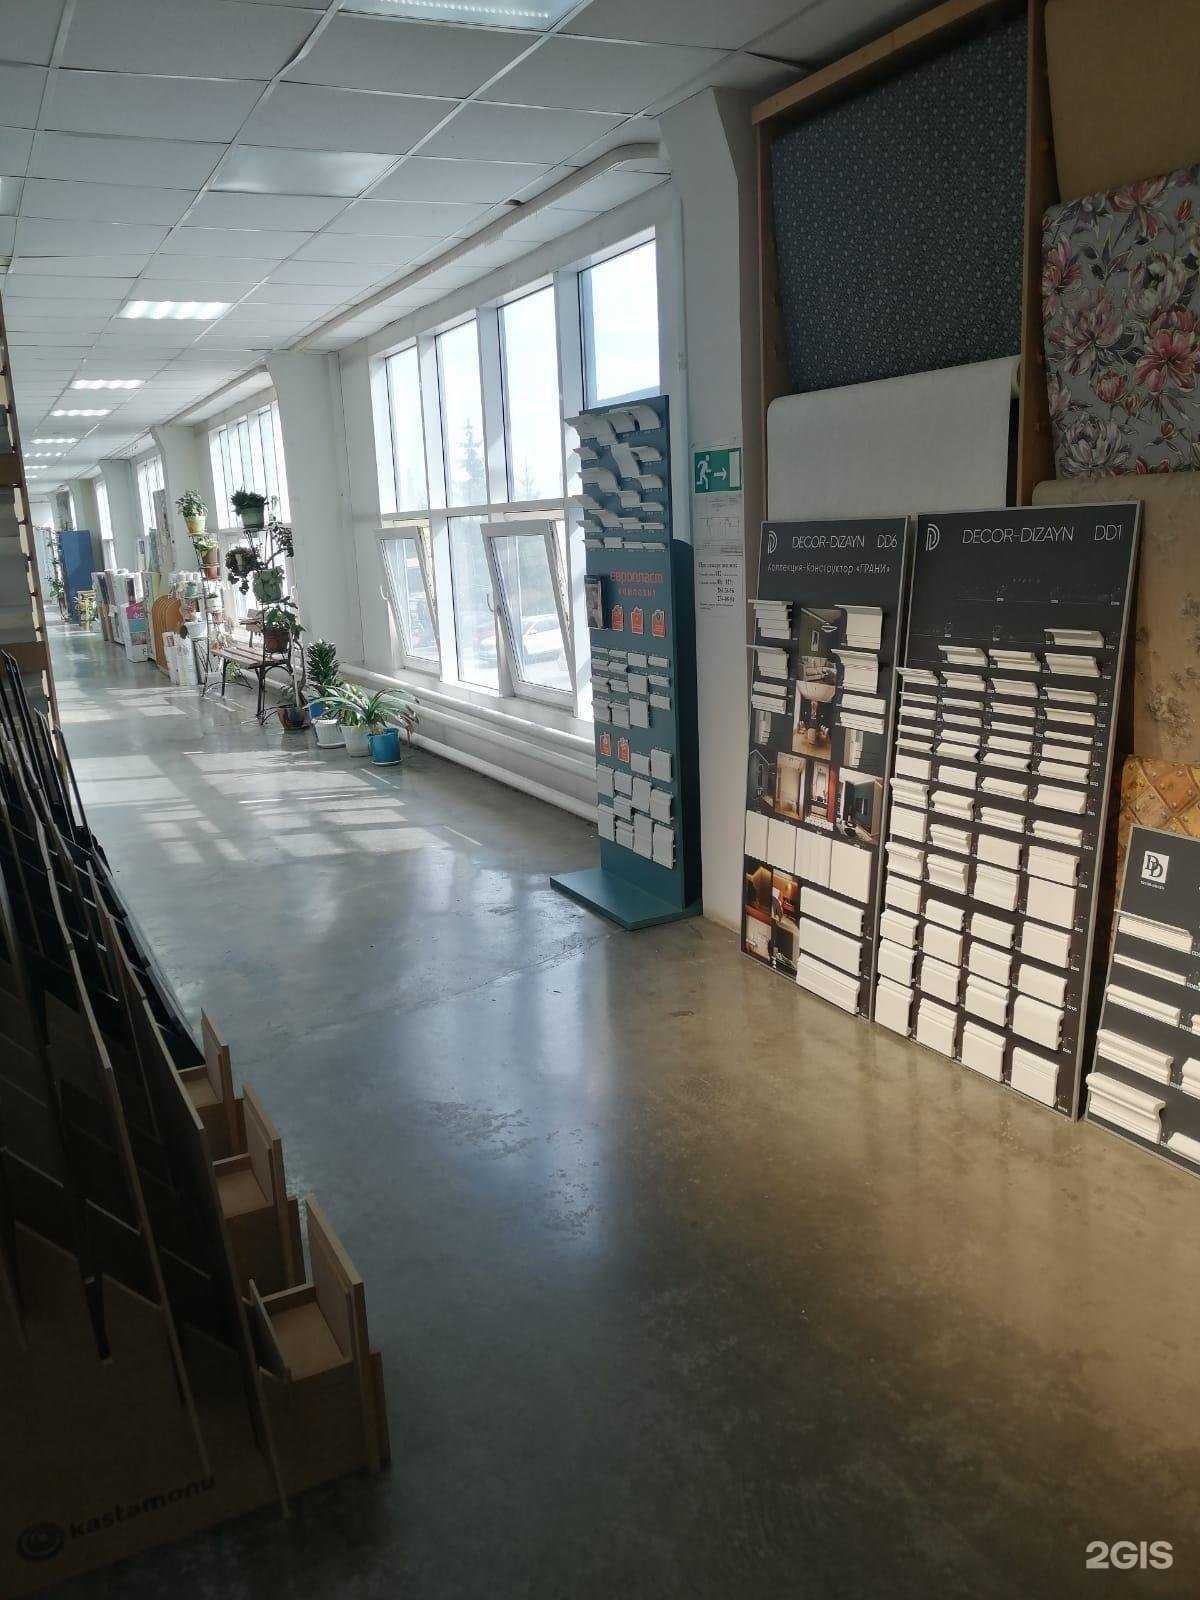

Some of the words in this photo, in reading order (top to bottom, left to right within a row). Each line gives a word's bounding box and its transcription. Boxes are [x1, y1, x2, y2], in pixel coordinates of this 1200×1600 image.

[792, 535, 865, 549] DECOR-DIZAYN
[877, 534, 898, 548] DD6
[962, 526, 1075, 544] DECOR-DIZAYN
[1094, 524, 1122, 541] DD1
[69, 1475, 216, 1539] kastamonu
